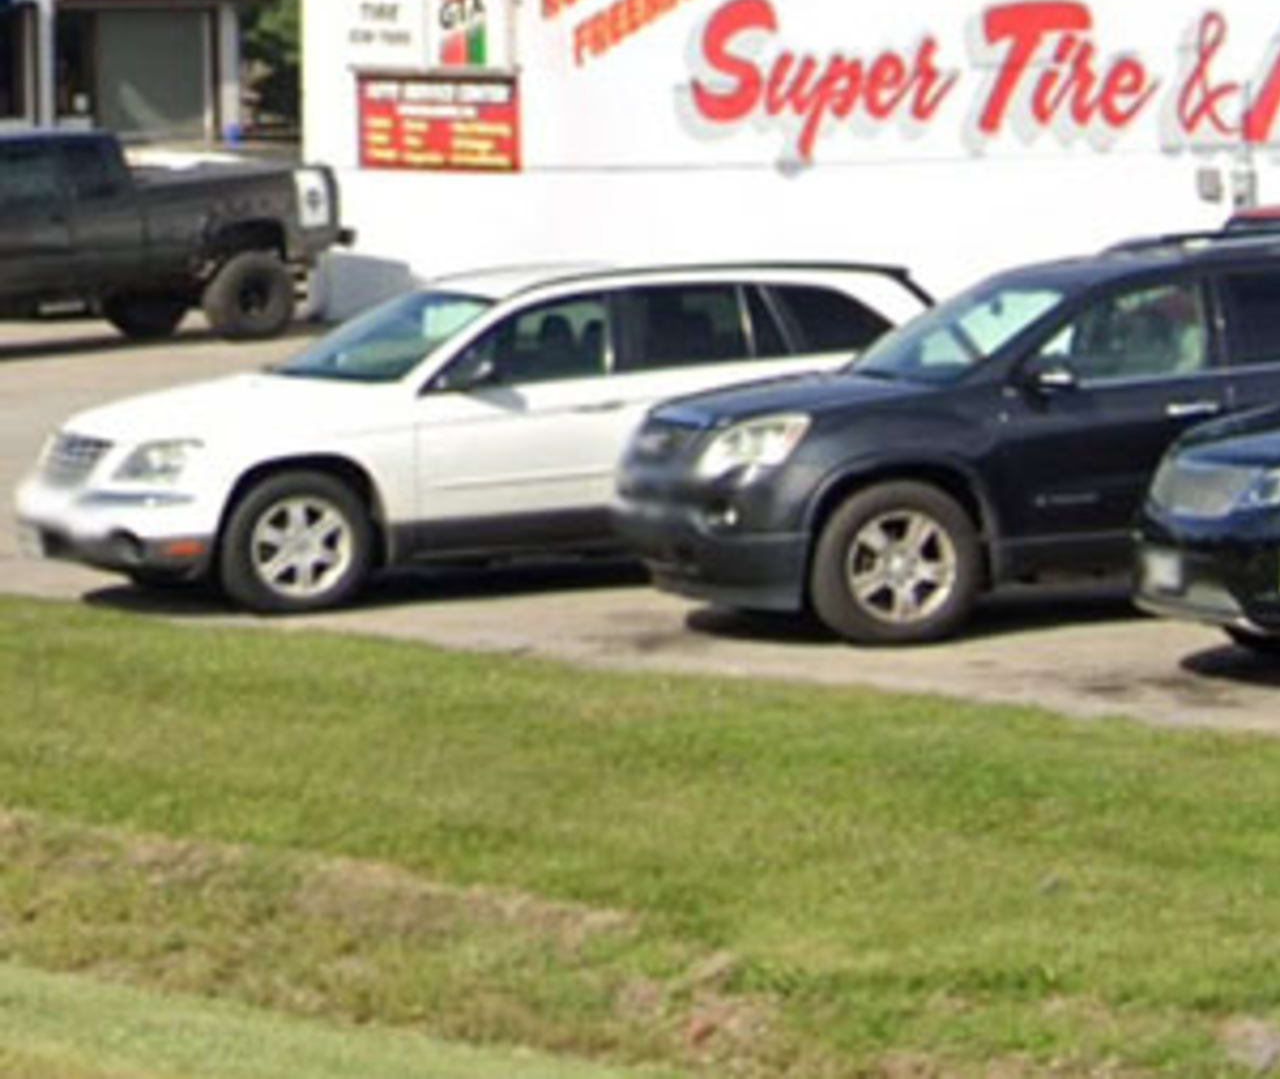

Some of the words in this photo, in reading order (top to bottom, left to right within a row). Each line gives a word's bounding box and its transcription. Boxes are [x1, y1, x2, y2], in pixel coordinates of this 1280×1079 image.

[360, 2, 400, 21] TIRE
[978, 0, 1158, 133] Tire
[1178, 11, 1241, 134] &
